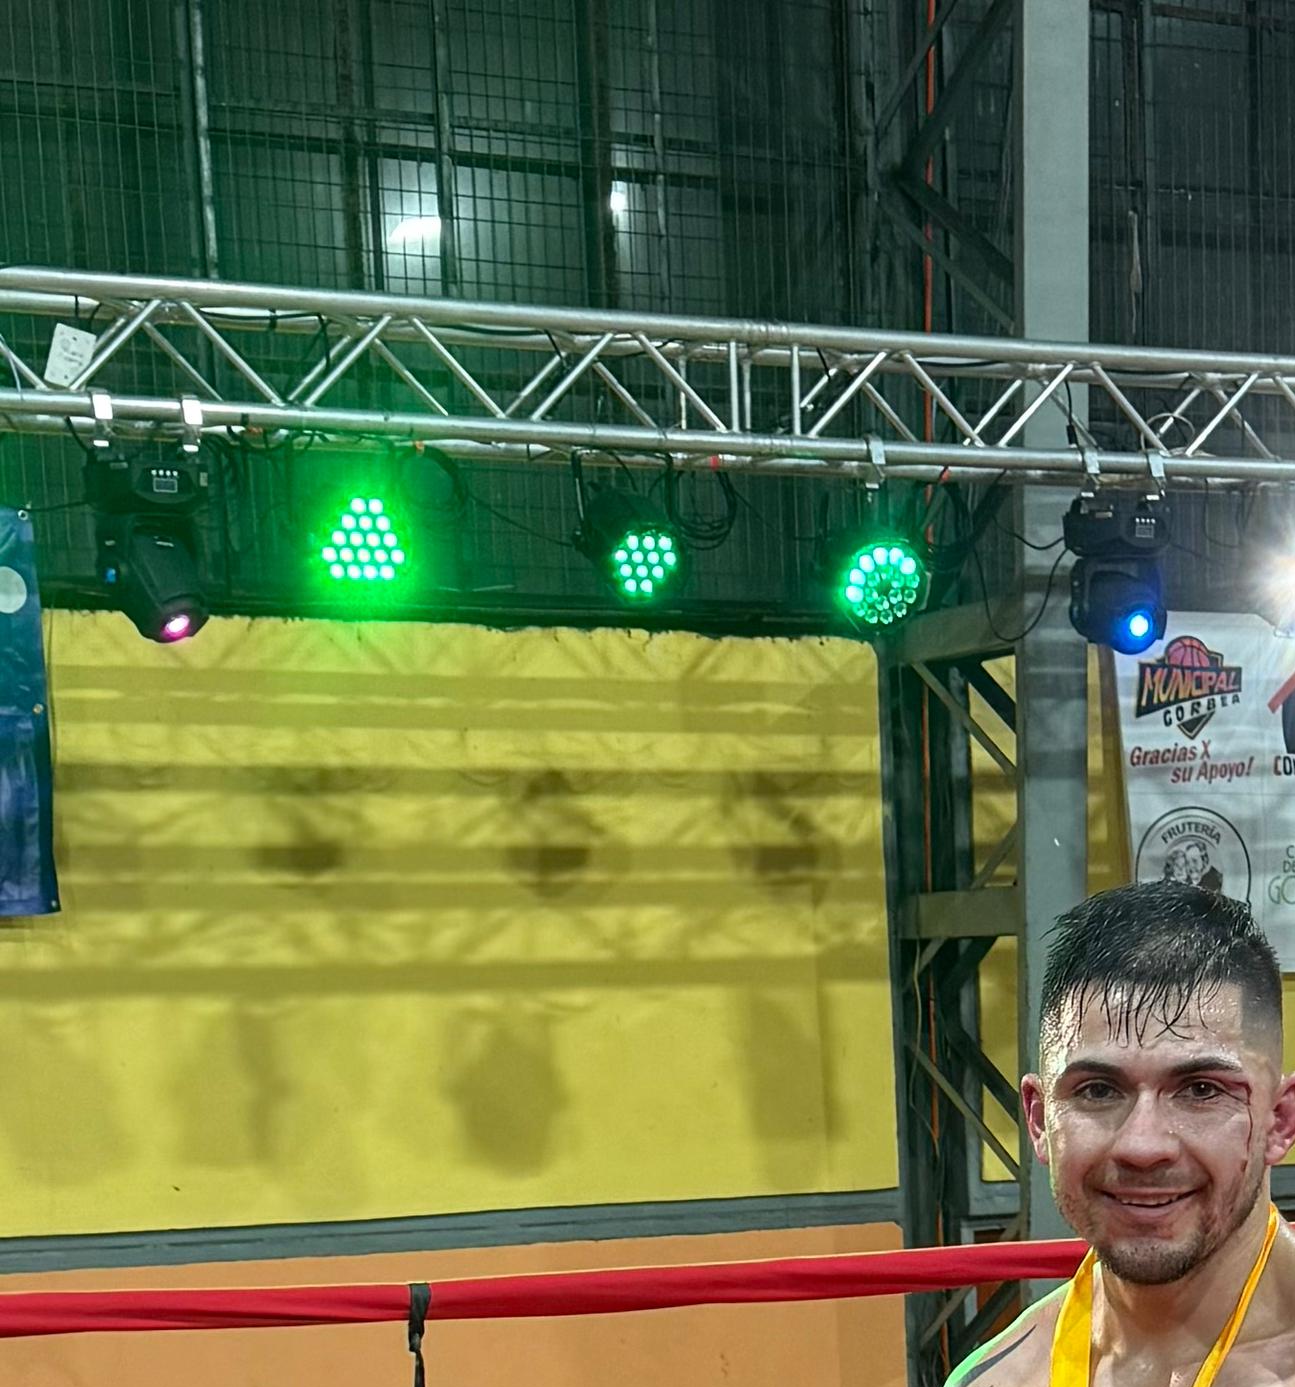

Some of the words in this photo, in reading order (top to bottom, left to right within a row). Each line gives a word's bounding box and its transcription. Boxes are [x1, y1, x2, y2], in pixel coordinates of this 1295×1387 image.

[1141, 666, 1241, 707] MUNICIPAL
[1163, 694, 1241, 727] GORBEA
[1130, 742, 1197, 767] Gracias
[1200, 740, 1211, 760] X
[1170, 766, 1193, 784] su
[1196, 757, 1255, 785] Apoyo!
